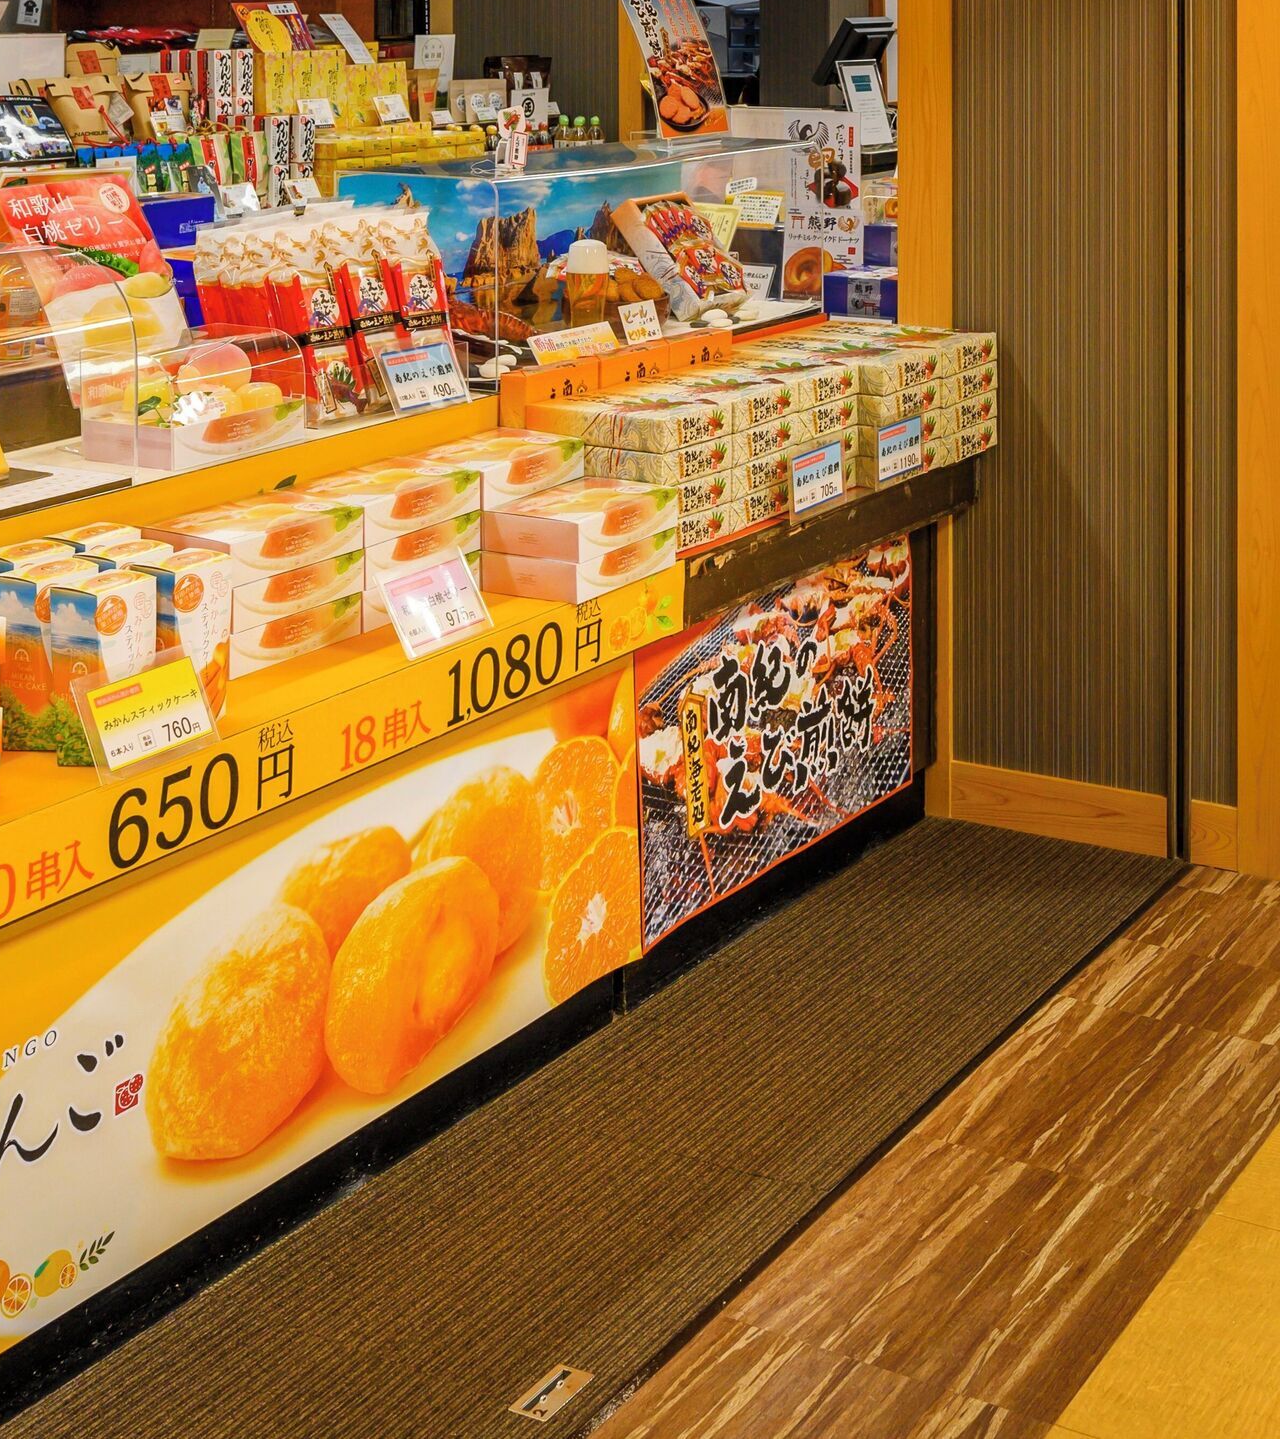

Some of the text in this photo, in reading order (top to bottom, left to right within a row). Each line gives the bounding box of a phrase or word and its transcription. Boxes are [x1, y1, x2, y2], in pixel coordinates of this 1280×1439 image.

[7, 192, 75, 220] 和歌山
[807, 215, 837, 231] 熊野
[22, 215, 124, 246] 白桃ゼリー
[395, 363, 453, 383] 南紀のえび煎餅
[445, 606, 476, 627] 975円
[576, 596, 602, 623] 税込
[126, 624, 135, 672] スティック
[104, 688, 198, 731] みかんスティックケーキ
[341, 618, 602, 772] 18串入 1,080円
[708, 639, 818, 743] 南紀の
[110, 743, 134, 758] 6本入り
[162, 716, 201, 743] 760円
[258, 718, 293, 753] 税込
[719, 664, 876, 830] えび煎餅
[684, 708, 706, 826] 南紀海老処
[109, 744, 295, 868] 650円
